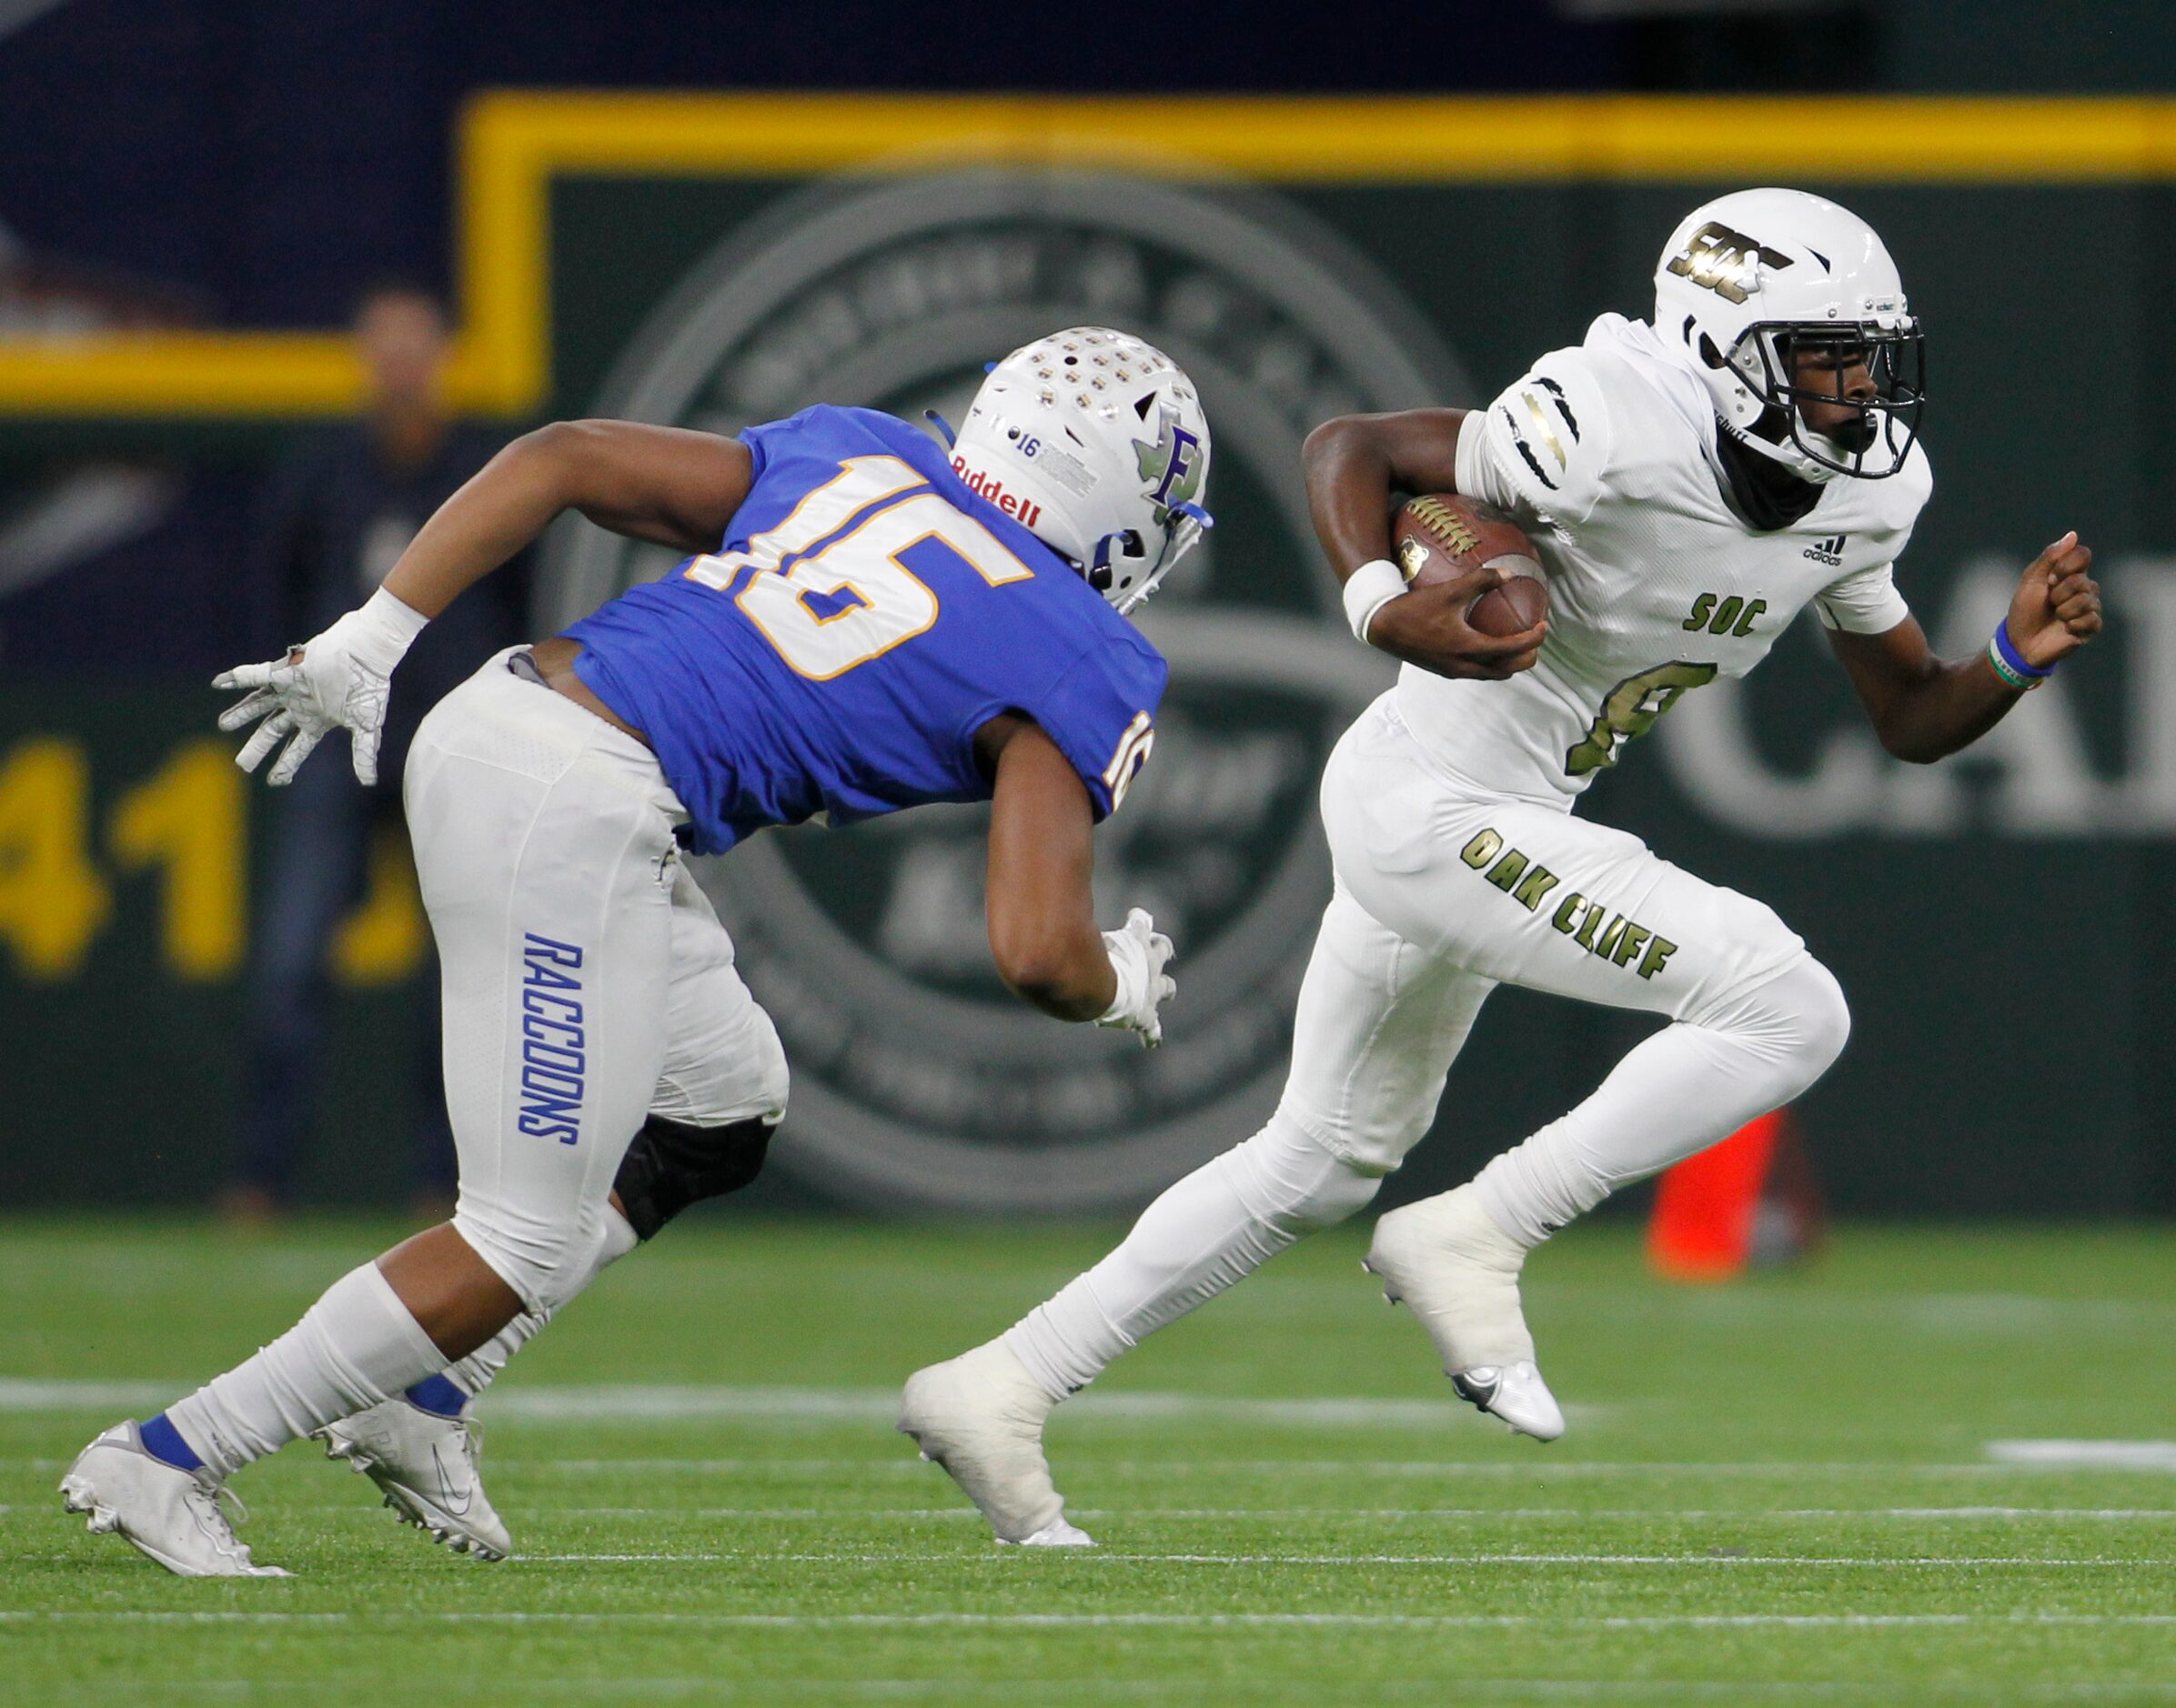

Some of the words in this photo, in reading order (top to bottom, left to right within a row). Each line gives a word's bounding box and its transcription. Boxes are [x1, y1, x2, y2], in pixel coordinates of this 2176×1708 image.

[1016, 433, 1041, 457] 16
[1142, 423, 1200, 508] F
[952, 456, 1042, 527] Riddell
[684, 455, 1035, 681] 16
[1803, 548, 1842, 567] adidas
[1683, 593, 1766, 637] SOC
[1459, 828, 1560, 912] OAK
[1552, 892, 1678, 980] CLIFF
[518, 932, 585, 1146] RACCOONS
